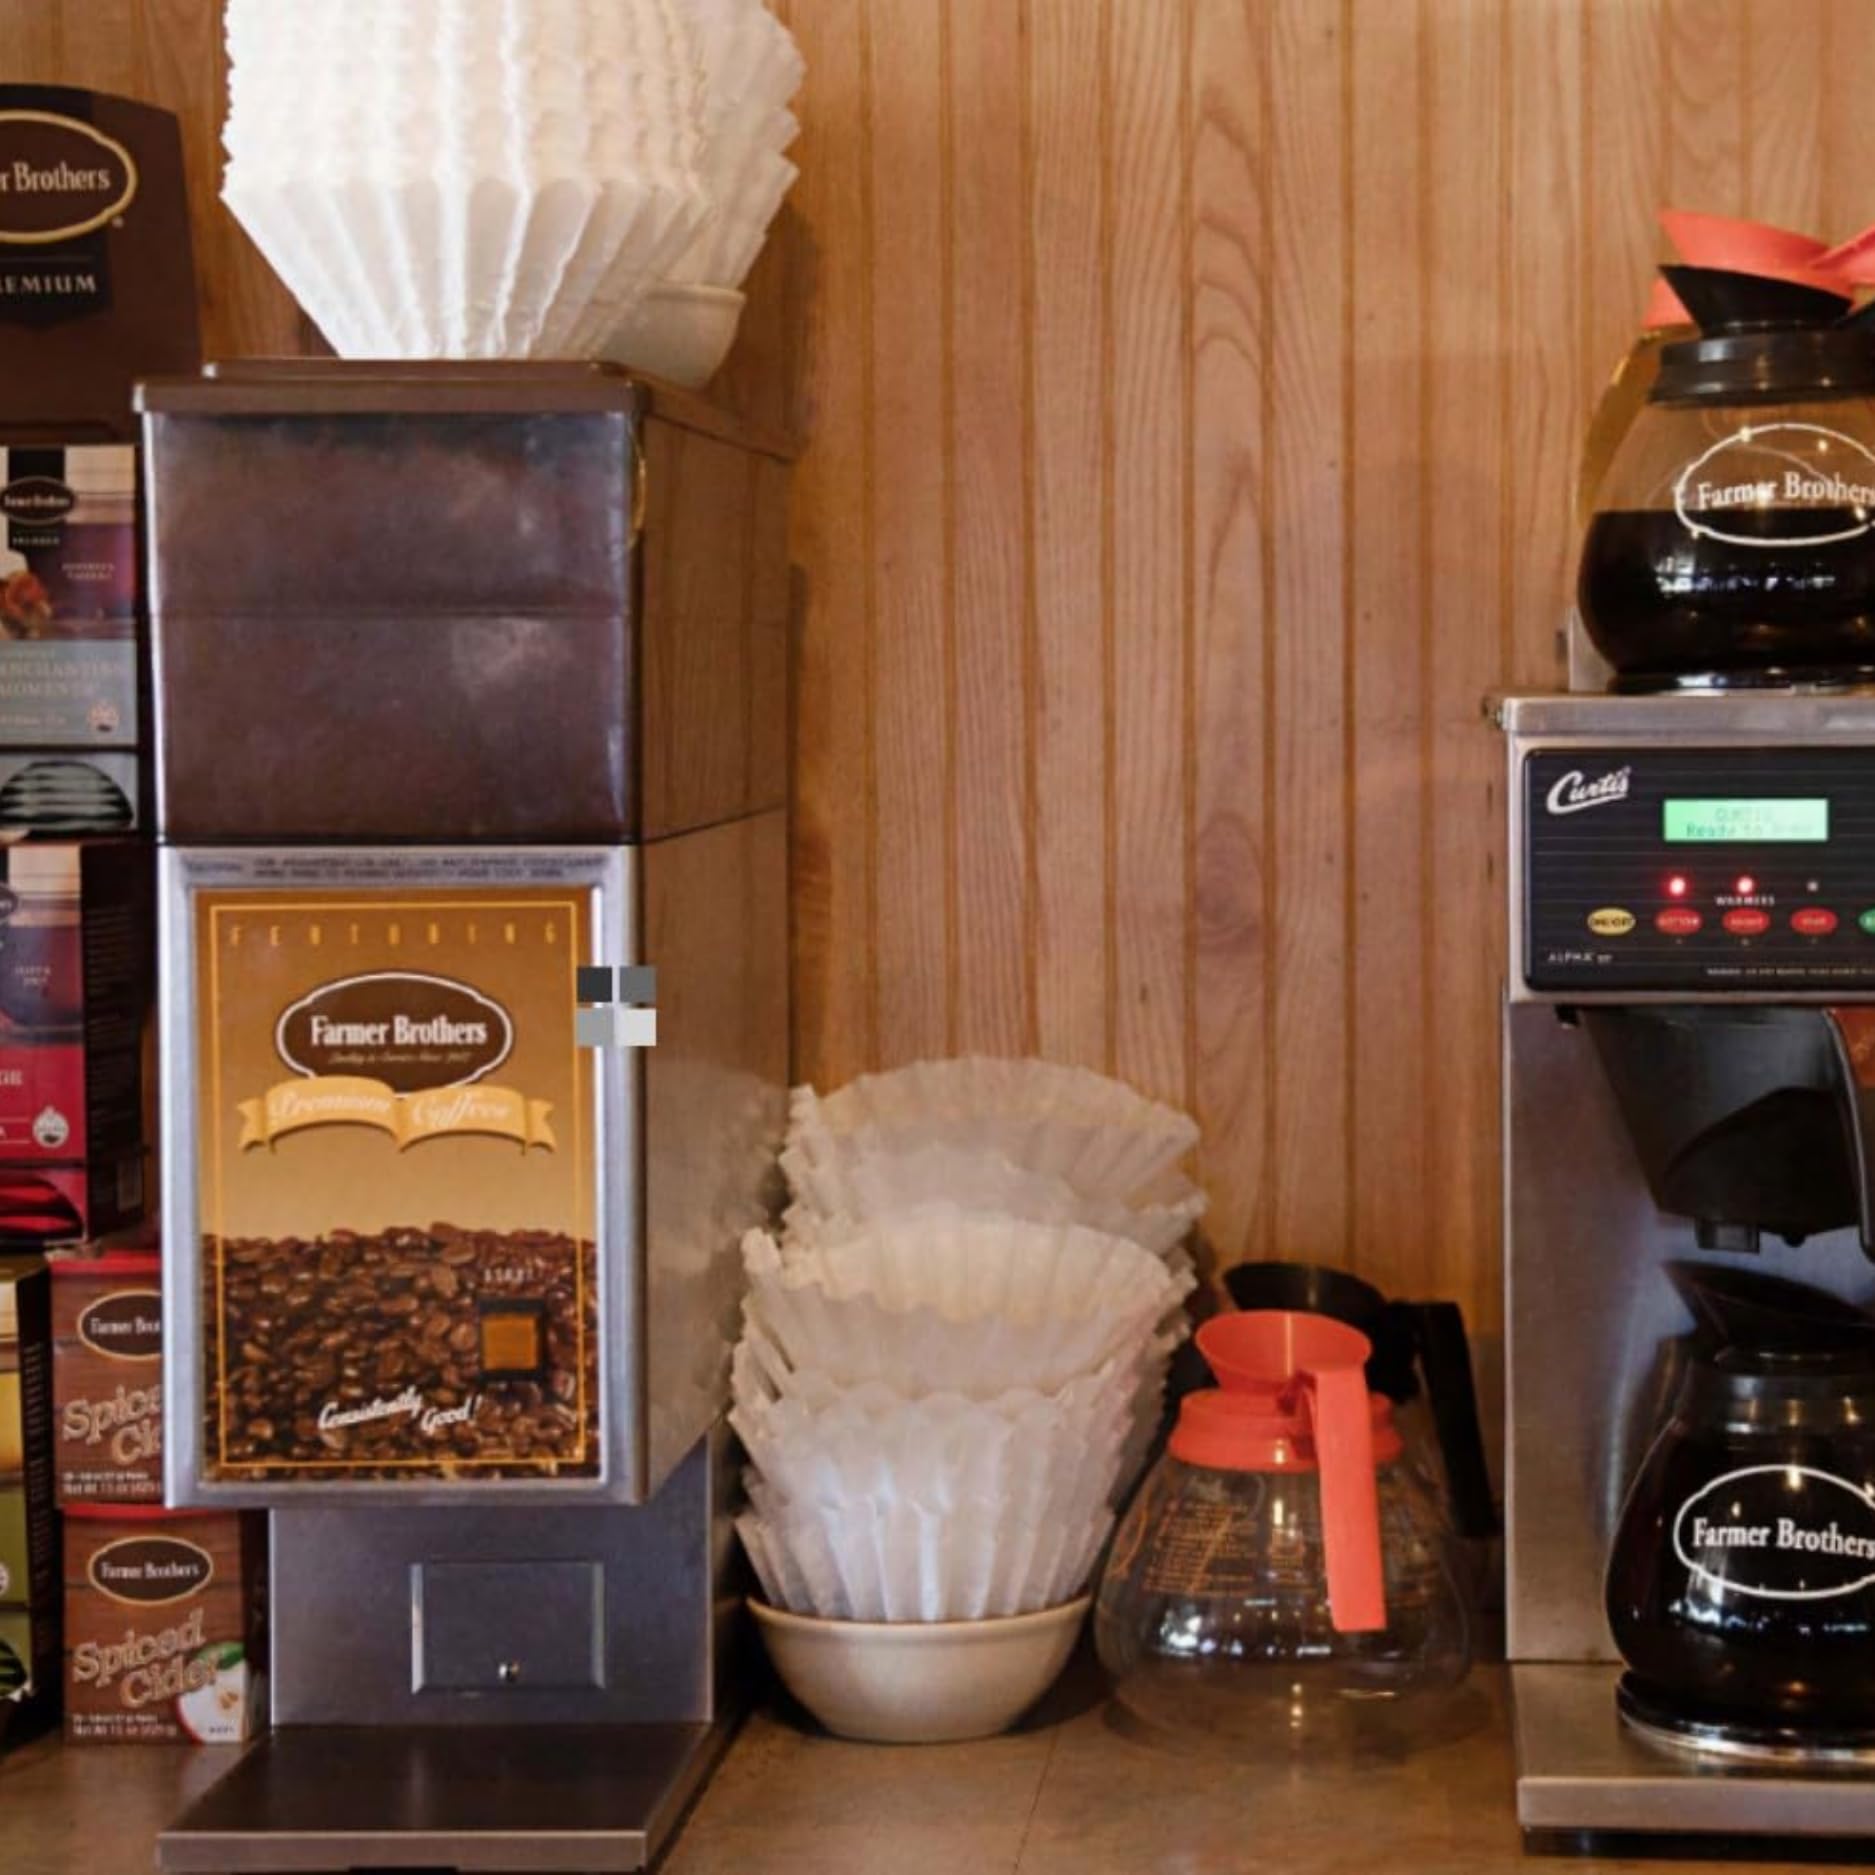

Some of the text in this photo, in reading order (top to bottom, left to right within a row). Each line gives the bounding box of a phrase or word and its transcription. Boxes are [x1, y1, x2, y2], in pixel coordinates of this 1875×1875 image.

[12, 160, 111, 192] Brothers
[0, 273, 97, 294] EMIUM
[1697, 481, 1777, 510] Farmer
[1547, 765, 1631, 814] Curtis
[311, 1015, 487, 1046] Farmer Brothers
[1692, 1517, 1875, 1559] Farmer Brothers
[73, 1607, 207, 1689] Spiced
[120, 1653, 222, 1708] Cider
